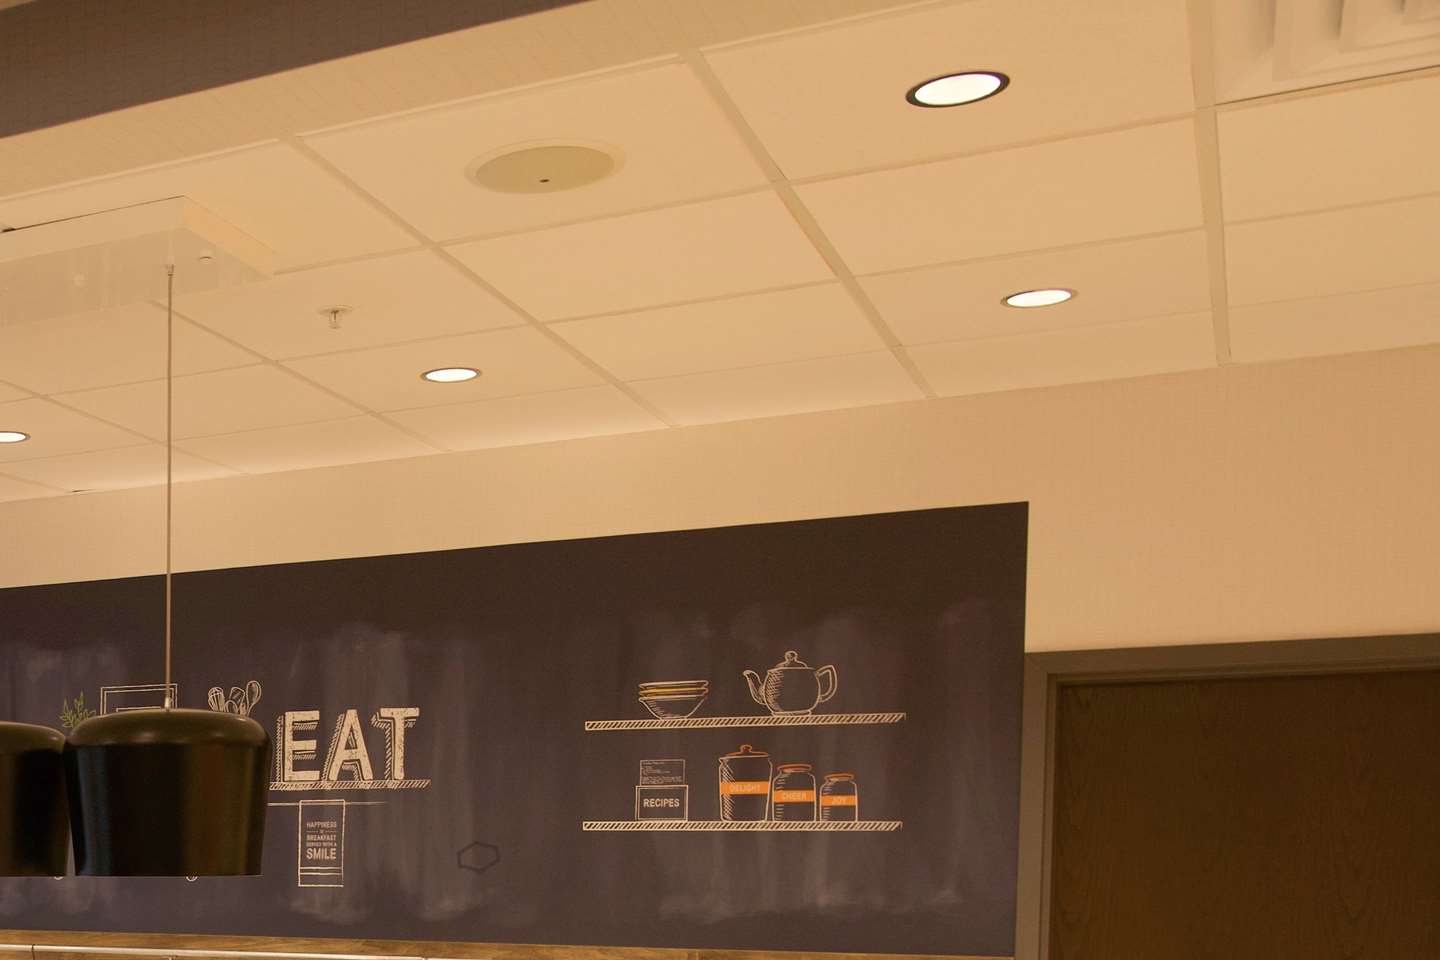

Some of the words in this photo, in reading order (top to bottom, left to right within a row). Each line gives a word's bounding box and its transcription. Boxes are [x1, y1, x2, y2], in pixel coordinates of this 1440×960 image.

[275, 707, 420, 781] EAT
[729, 784, 761, 793] DELIGHT
[780, 791, 807, 801] CHEER
[832, 797, 847, 805] JOY
[643, 798, 680, 808] RECIPES
[306, 821, 337, 829] HAPPINESS
[306, 848, 336, 860] SMILE
